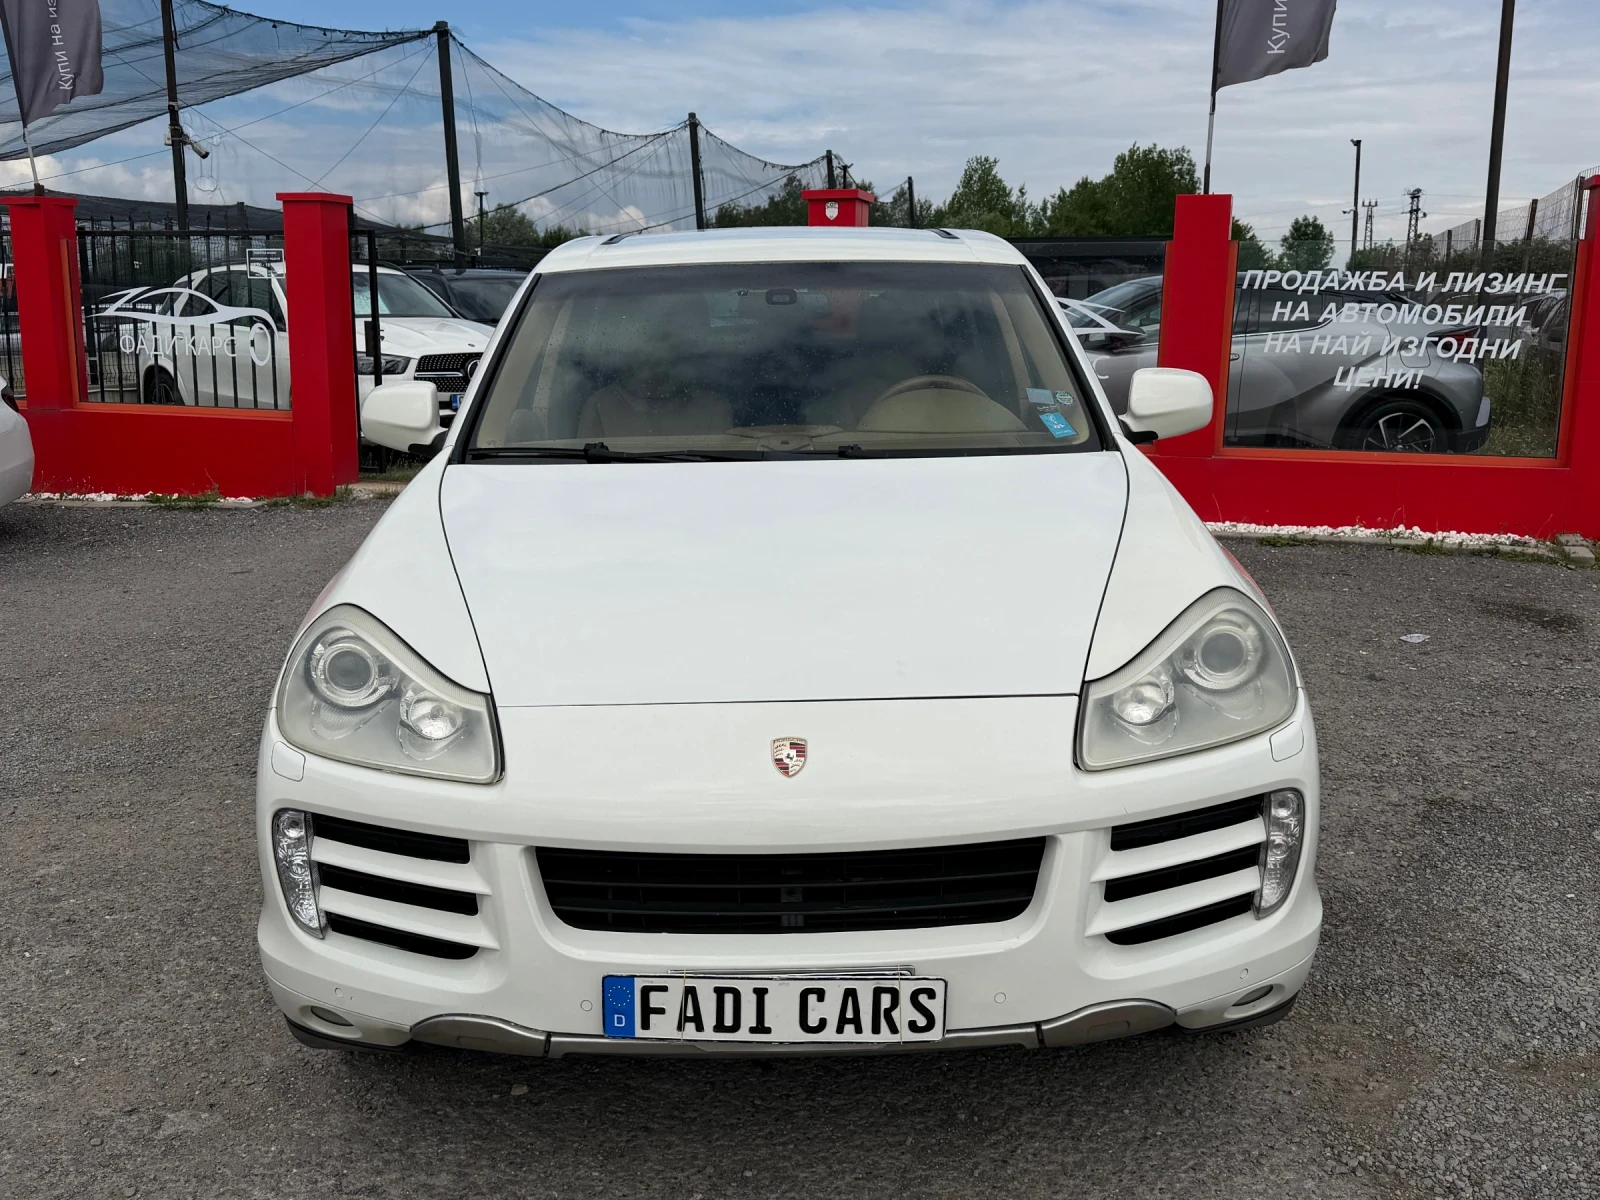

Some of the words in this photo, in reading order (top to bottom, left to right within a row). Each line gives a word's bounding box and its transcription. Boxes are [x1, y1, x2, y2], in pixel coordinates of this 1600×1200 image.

[50, 24, 64, 46] на
[1266, 0, 1290, 54] Купи
[55, 51, 74, 90] Купи
[1242, 269, 1405, 295] ПРОДАЖБА
[1415, 271, 1437, 292] И
[1441, 271, 1568, 294] ЛИЗИНГ
[1271, 301, 1310, 322] НА
[1318, 302, 1527, 327] АВТОМОБИЛИ
[119, 334, 179, 359] ФАДИ
[184, 336, 237, 357] КАРС
[1263, 332, 1301, 354] НА
[1309, 330, 1372, 356] НАЙ
[1379, 336, 1522, 364] ИЗГОДНИ
[1332, 366, 1424, 392] ЦЕНИ!
[614, 1014, 626, 1027] D
[640, 985, 772, 1034] FADI
[799, 986, 937, 1035] CARS
